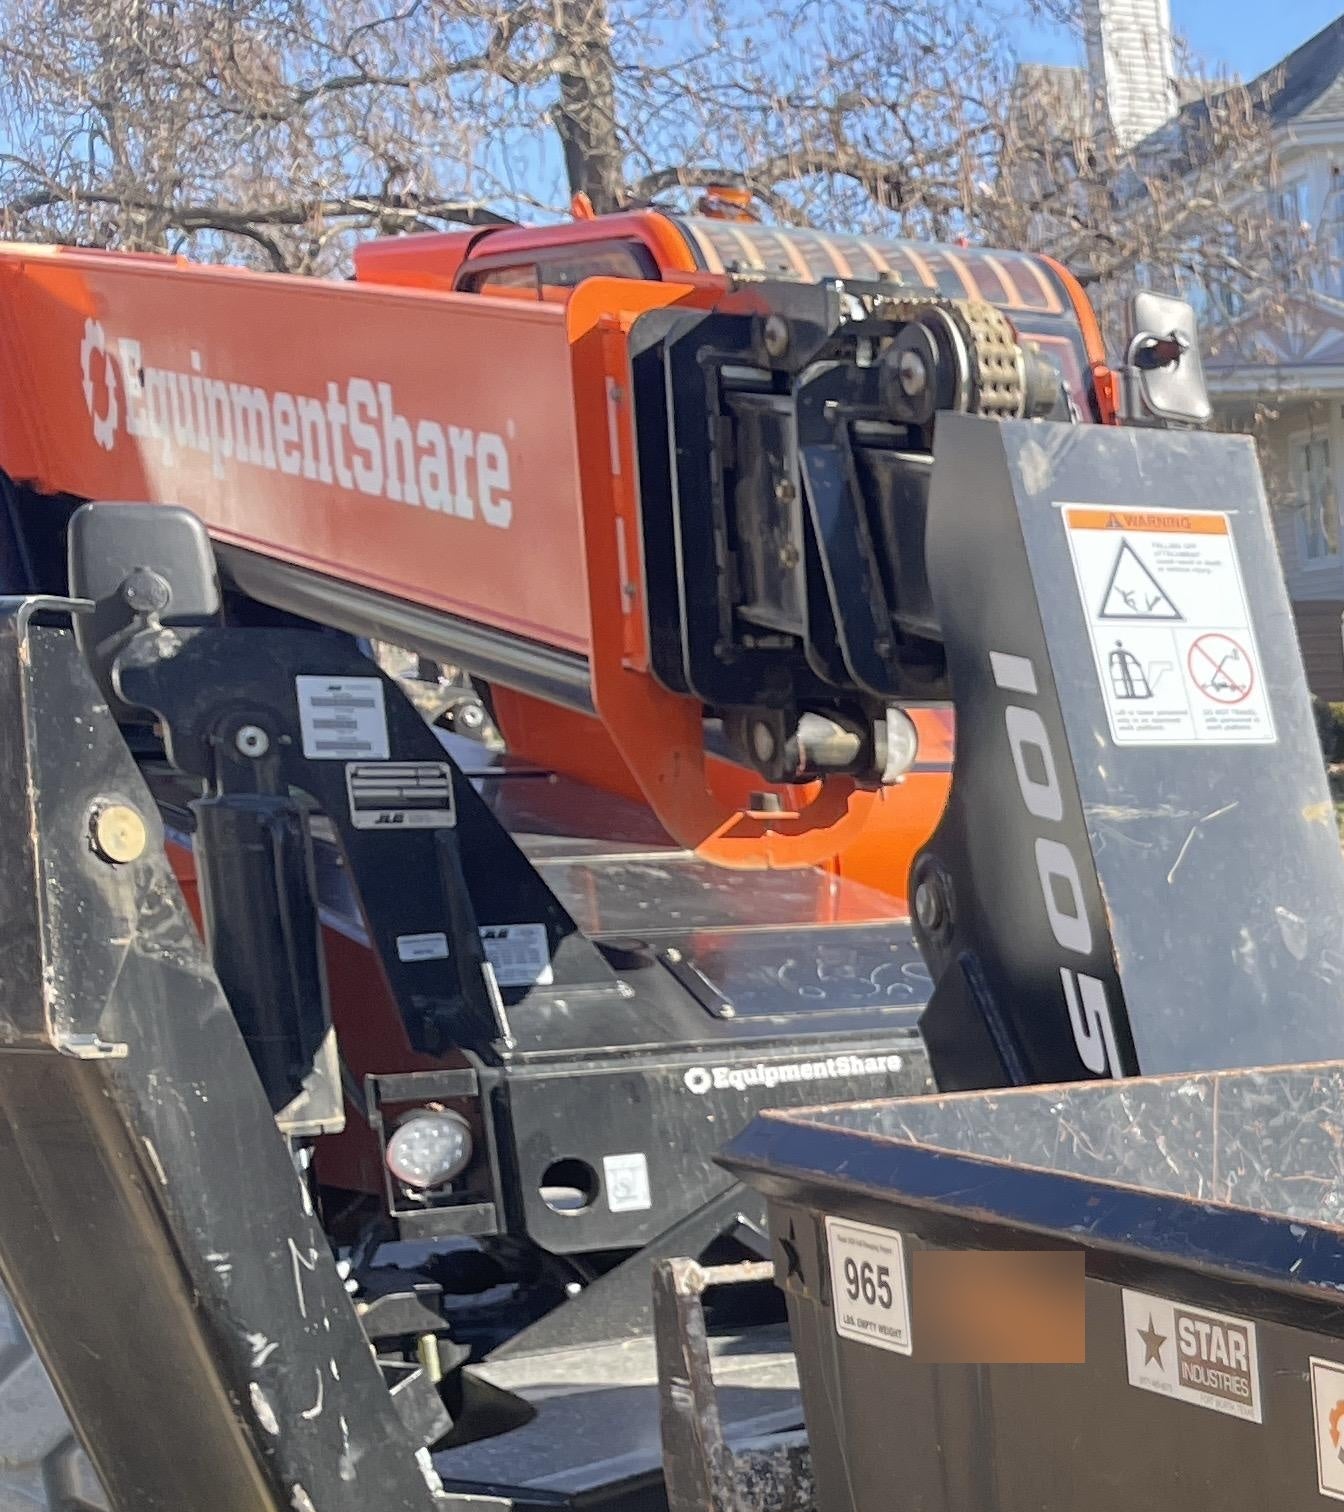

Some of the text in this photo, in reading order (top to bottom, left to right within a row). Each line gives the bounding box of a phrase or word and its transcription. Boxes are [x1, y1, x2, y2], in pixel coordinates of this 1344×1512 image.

[117, 336, 514, 529] EquipmentShare
[1125, 513, 1192, 530] WARNING
[711, 1055, 902, 1092] EquipmentShare
[844, 1256, 893, 1310] 965
[1178, 1316, 1249, 1372] STAR
[1182, 1361, 1249, 1397] INDUSTRIES
